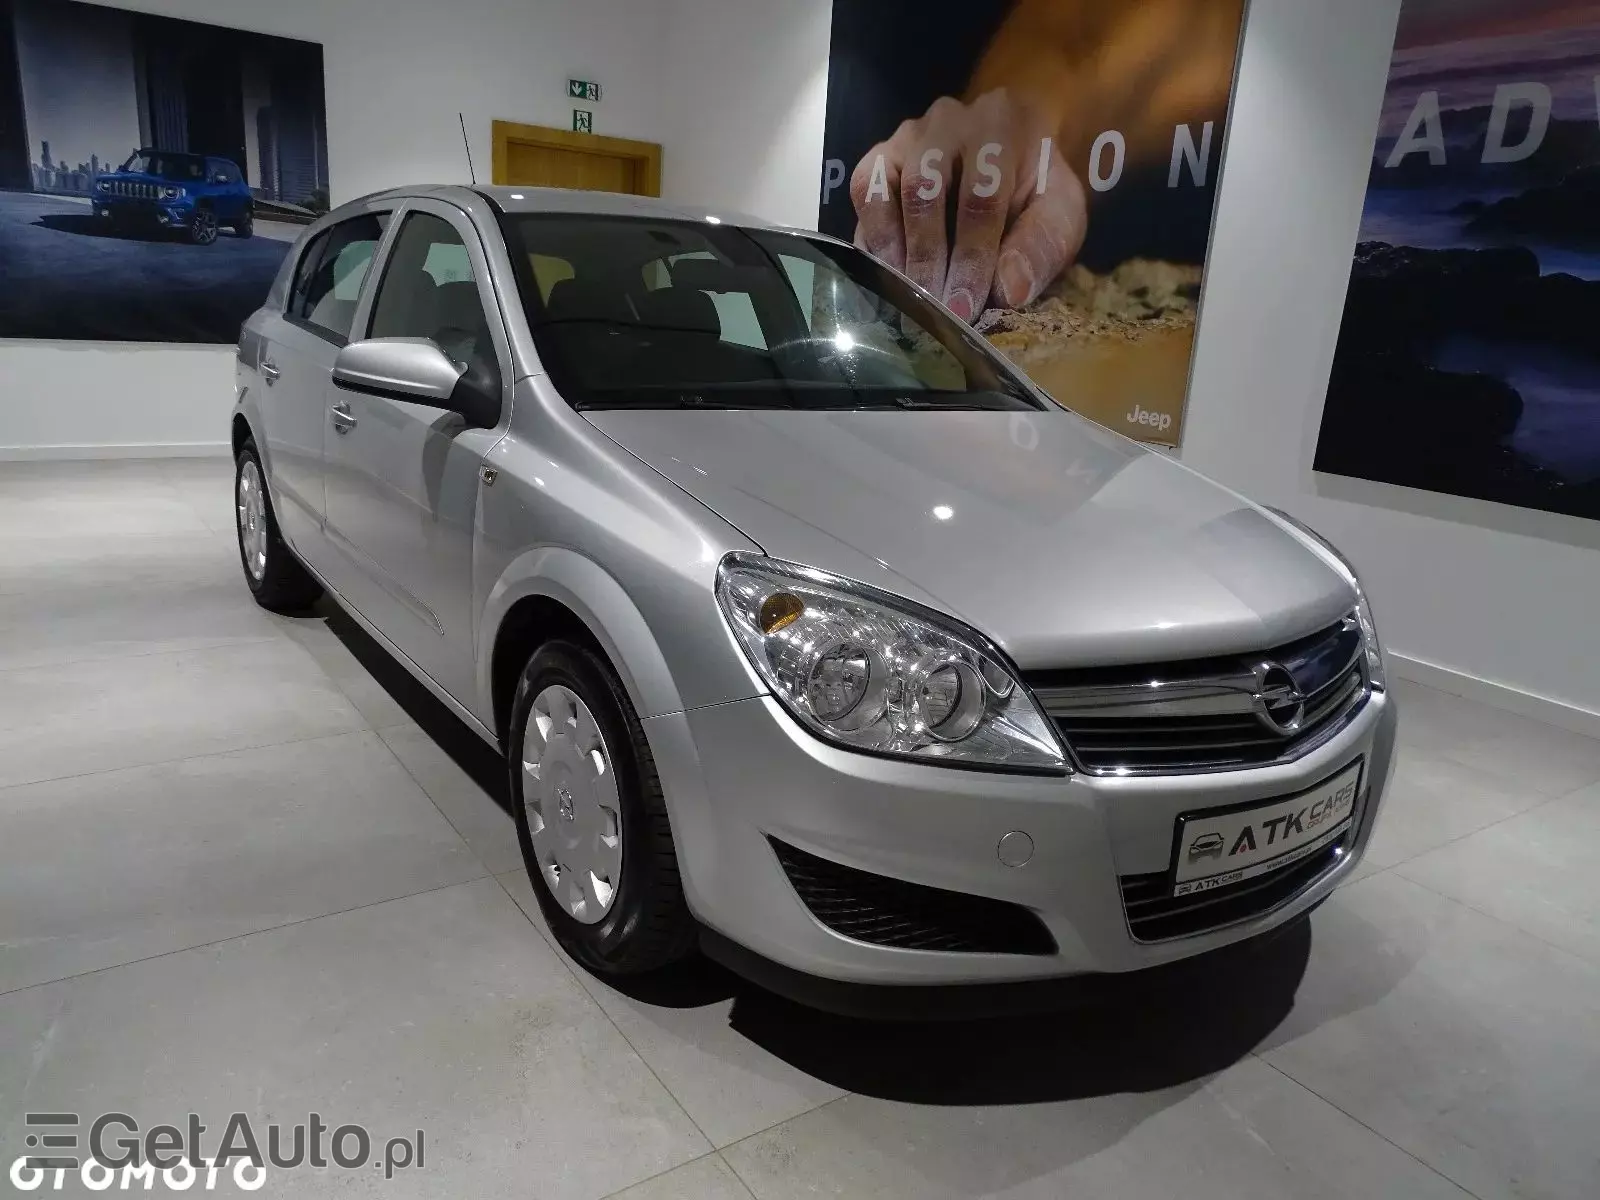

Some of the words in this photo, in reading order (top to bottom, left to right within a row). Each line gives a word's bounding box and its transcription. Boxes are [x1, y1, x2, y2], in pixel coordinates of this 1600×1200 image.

[1384, 75, 1600, 168] AD
[822, 121, 1213, 205] PASSION
[1126, 404, 1172, 431] Jeep
[1228, 807, 1308, 856] ATK
[1309, 780, 1355, 820] CARS
[1195, 877, 1221, 891] ATK
